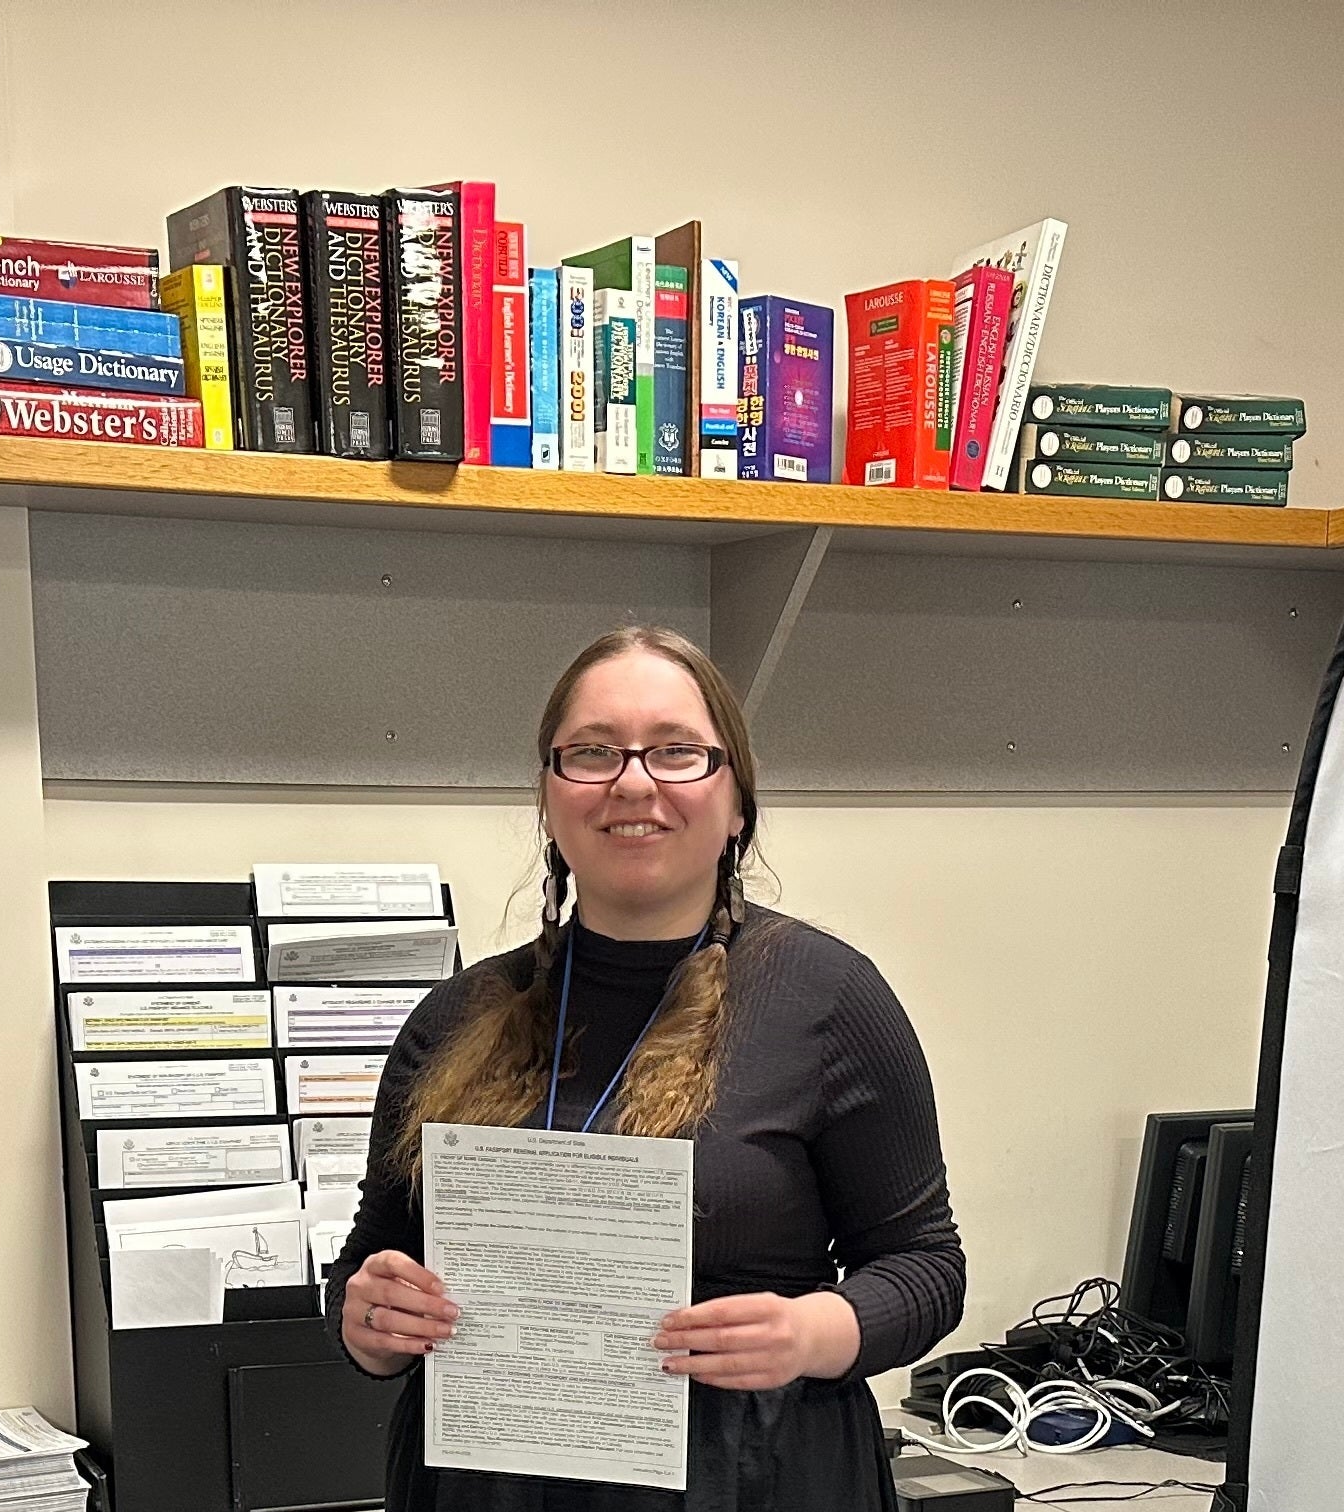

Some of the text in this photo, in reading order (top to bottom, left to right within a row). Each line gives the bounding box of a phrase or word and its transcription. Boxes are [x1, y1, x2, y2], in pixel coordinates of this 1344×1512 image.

[242, 195, 298, 213] WEBSTER'S
[324, 200, 381, 219] WEBSTER'S
[79, 269, 146, 287] LAROUSSE
[264, 228, 289, 363] DICTIONARY
[245, 224, 274, 402] AND THESAURUS
[282, 228, 307, 383] NEW EXPLORER
[327, 230, 351, 406] AND THESAURUS
[346, 231, 367, 368] DICTIONARY
[363, 234, 384, 388] NEW EXPLORER
[436, 231, 456, 384] NEW EXPLORER
[716, 296, 725, 339] KOREAN
[864, 291, 904, 311] LAROUSSE
[1010, 263, 1053, 421] DICTIONARY/DICCIONARIO
[14, 345, 74, 376] Usage
[78, 352, 179, 388] Dictionary
[716, 348, 725, 390] ENGLISH
[923, 343, 937, 430] LAROUSSE
[0, 400, 157, 441] Webster's
[1122, 404, 1160, 416] Dictionary
[1263, 412, 1295, 422] Dictionary
[1120, 443, 1153, 454] Dictionary
[1251, 448, 1283, 458] Dictionary
[1114, 476, 1149, 488] Dictionary
[1244, 485, 1277, 495] Dictionary
